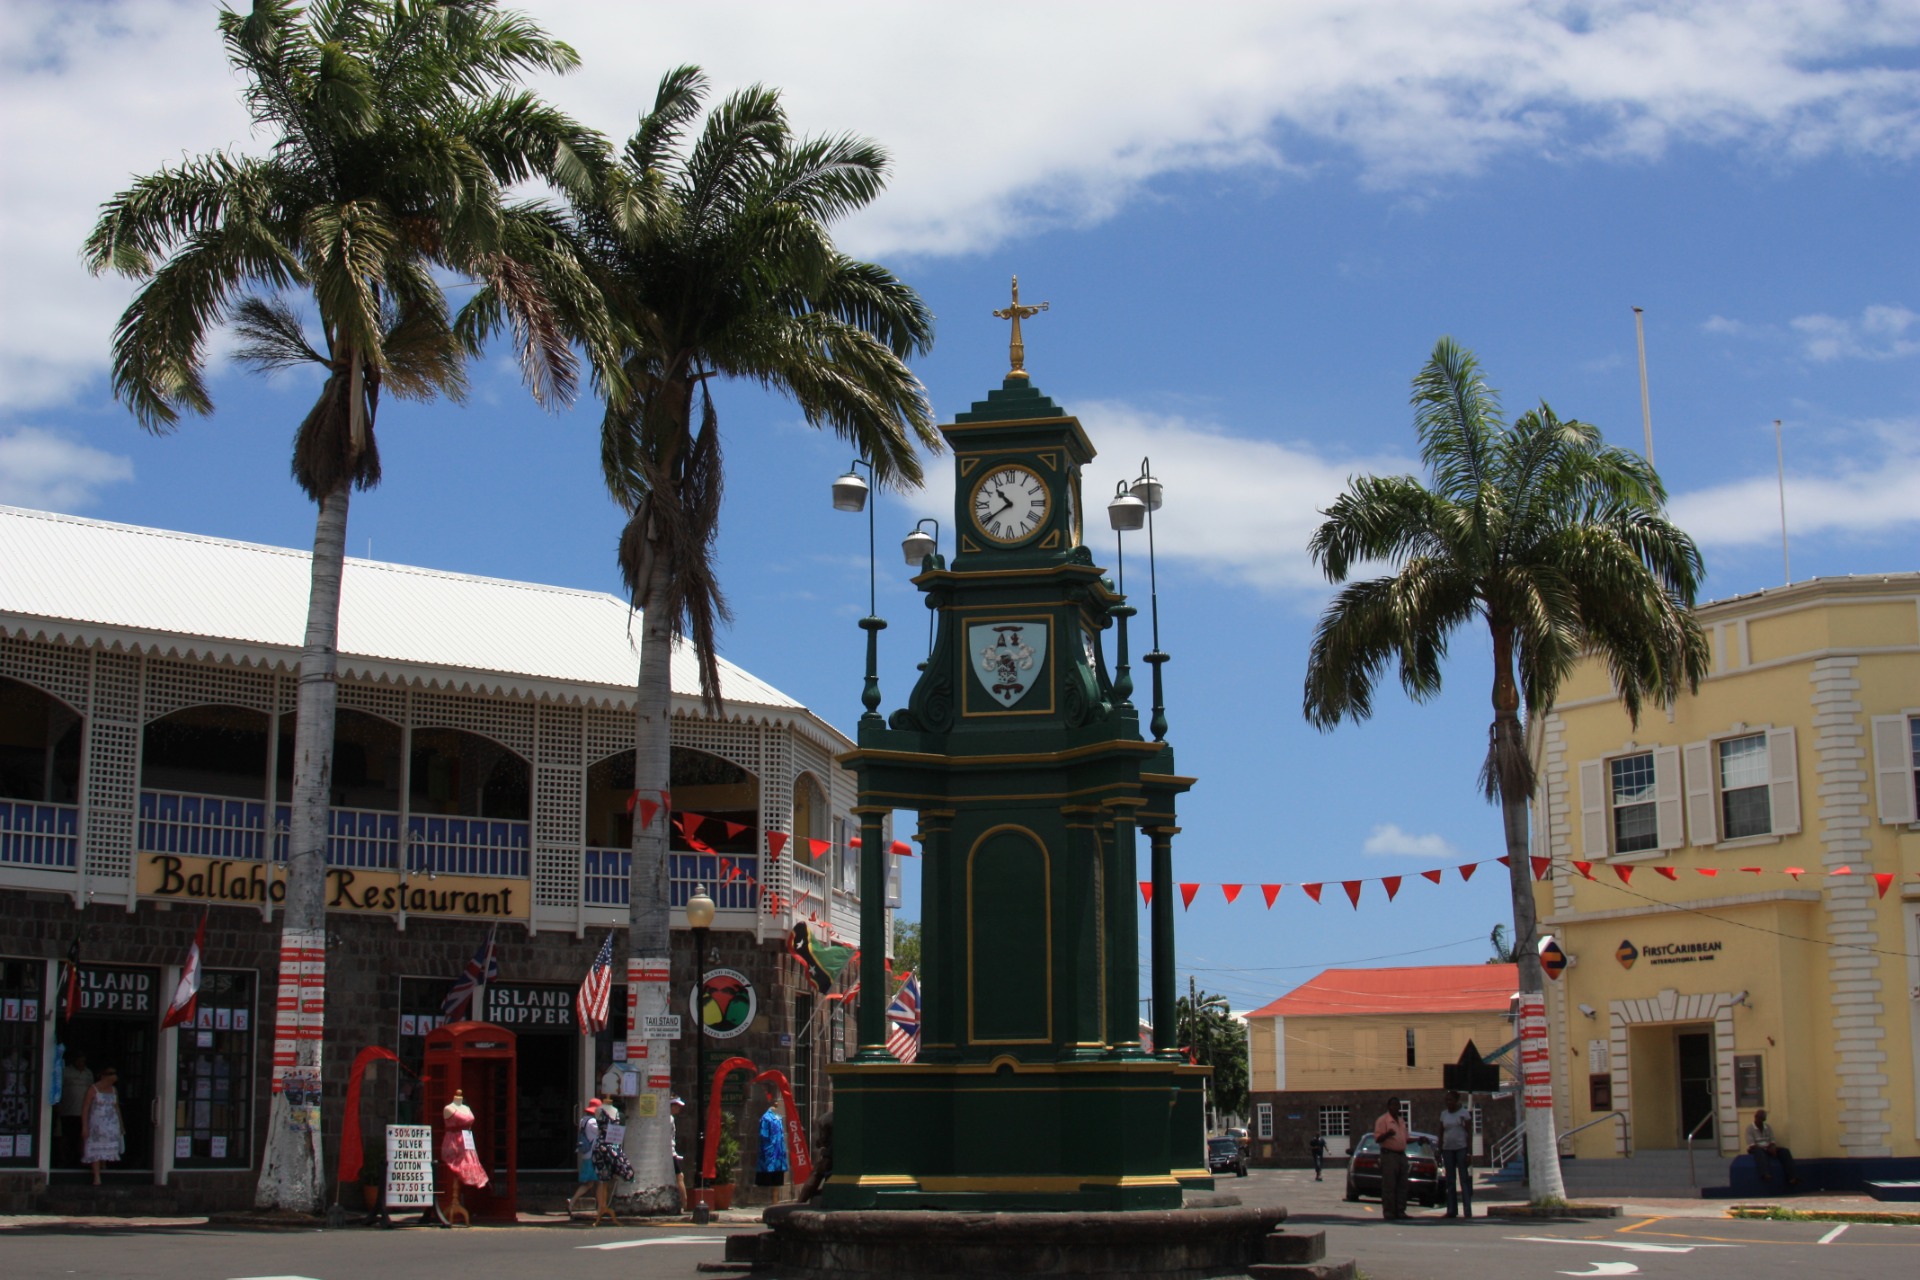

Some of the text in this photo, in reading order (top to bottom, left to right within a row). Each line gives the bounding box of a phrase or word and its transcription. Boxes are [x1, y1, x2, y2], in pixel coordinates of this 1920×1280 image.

[326, 869, 512, 915] Restaurant
[77, 971, 150, 991] SLAND
[61, 990, 150, 1010] OPPER
[489, 989, 570, 1007] ISLAND
[489, 1006, 570, 1024] HOPPER
[645, 1016, 679, 1025] TAXI STAND
[394, 1128, 424, 1138] 50% OFF
[398, 1139, 423, 1149] SILVER
[790, 1120, 806, 1166] SALE
[394, 1161, 422, 1170] COTTON
[391, 1172, 424, 1181] DRESSES
